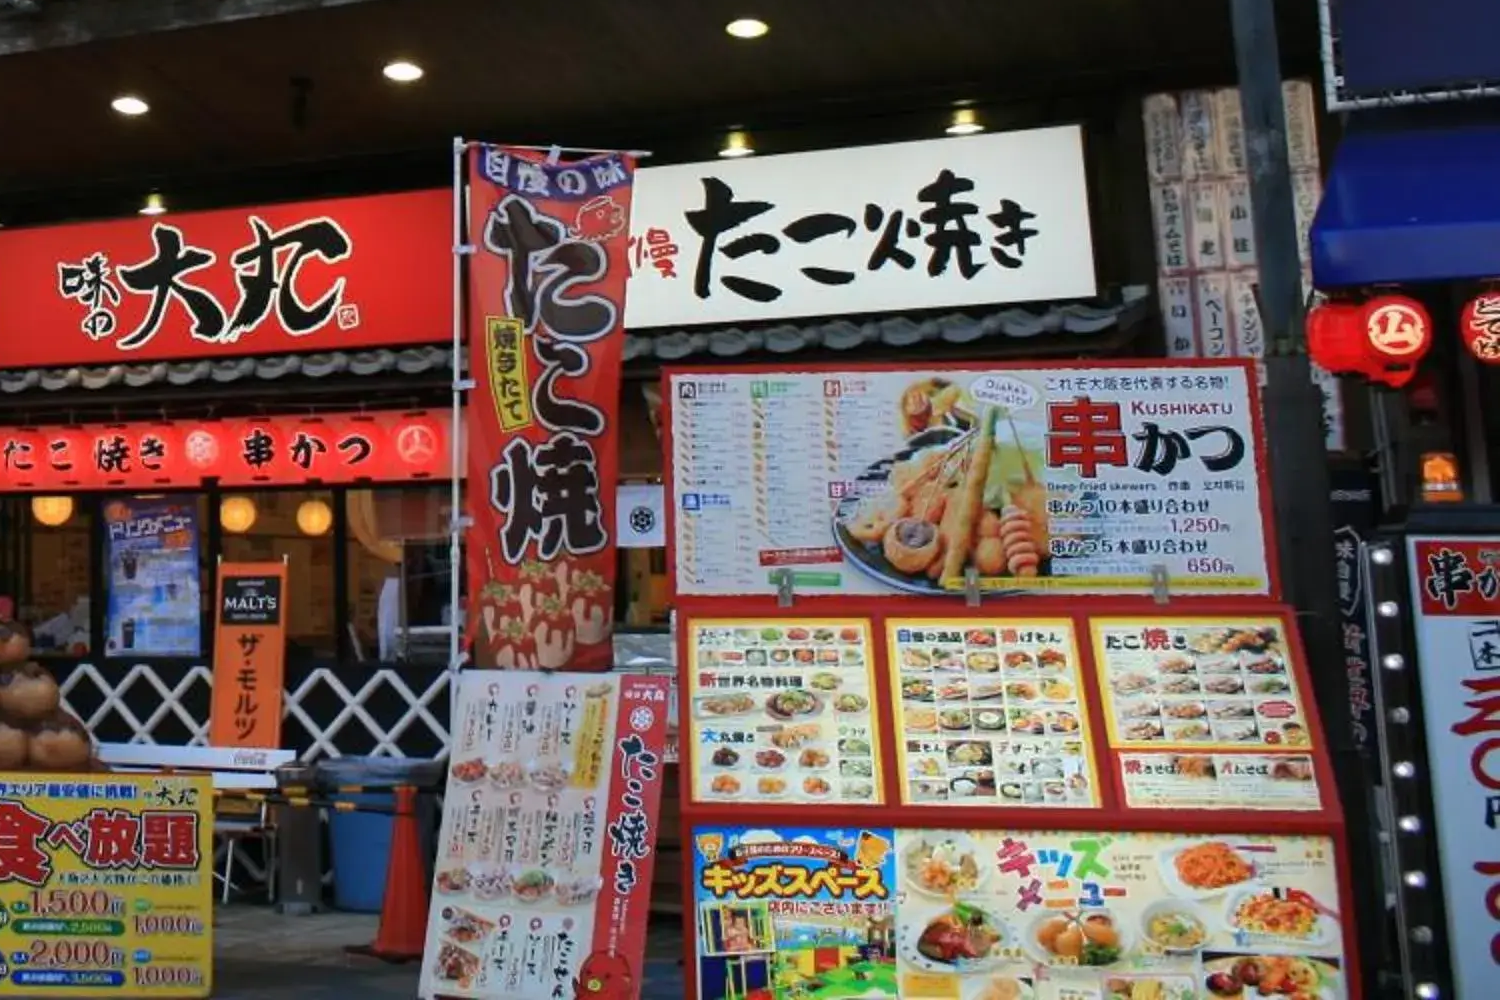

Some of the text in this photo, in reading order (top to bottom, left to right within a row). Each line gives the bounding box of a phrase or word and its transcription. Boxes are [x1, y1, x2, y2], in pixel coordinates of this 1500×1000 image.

[1046, 375, 1230, 391] これぞ大阪を代表する名物!
[1131, 401, 1233, 416] KUSHIKATU
[2, 426, 167, 473] たこ焼き
[241, 429, 375, 470] 串かつ
[1044, 394, 1245, 478] 串かつ
[1105, 628, 1187, 651] たこ焼き
[235, 633, 265, 741] ザ・モルツ
[700, 672, 804, 688] 新世界名物料理
[609, 734, 658, 895] たこ焼き
[702, 864, 889, 897] キッズスペース
